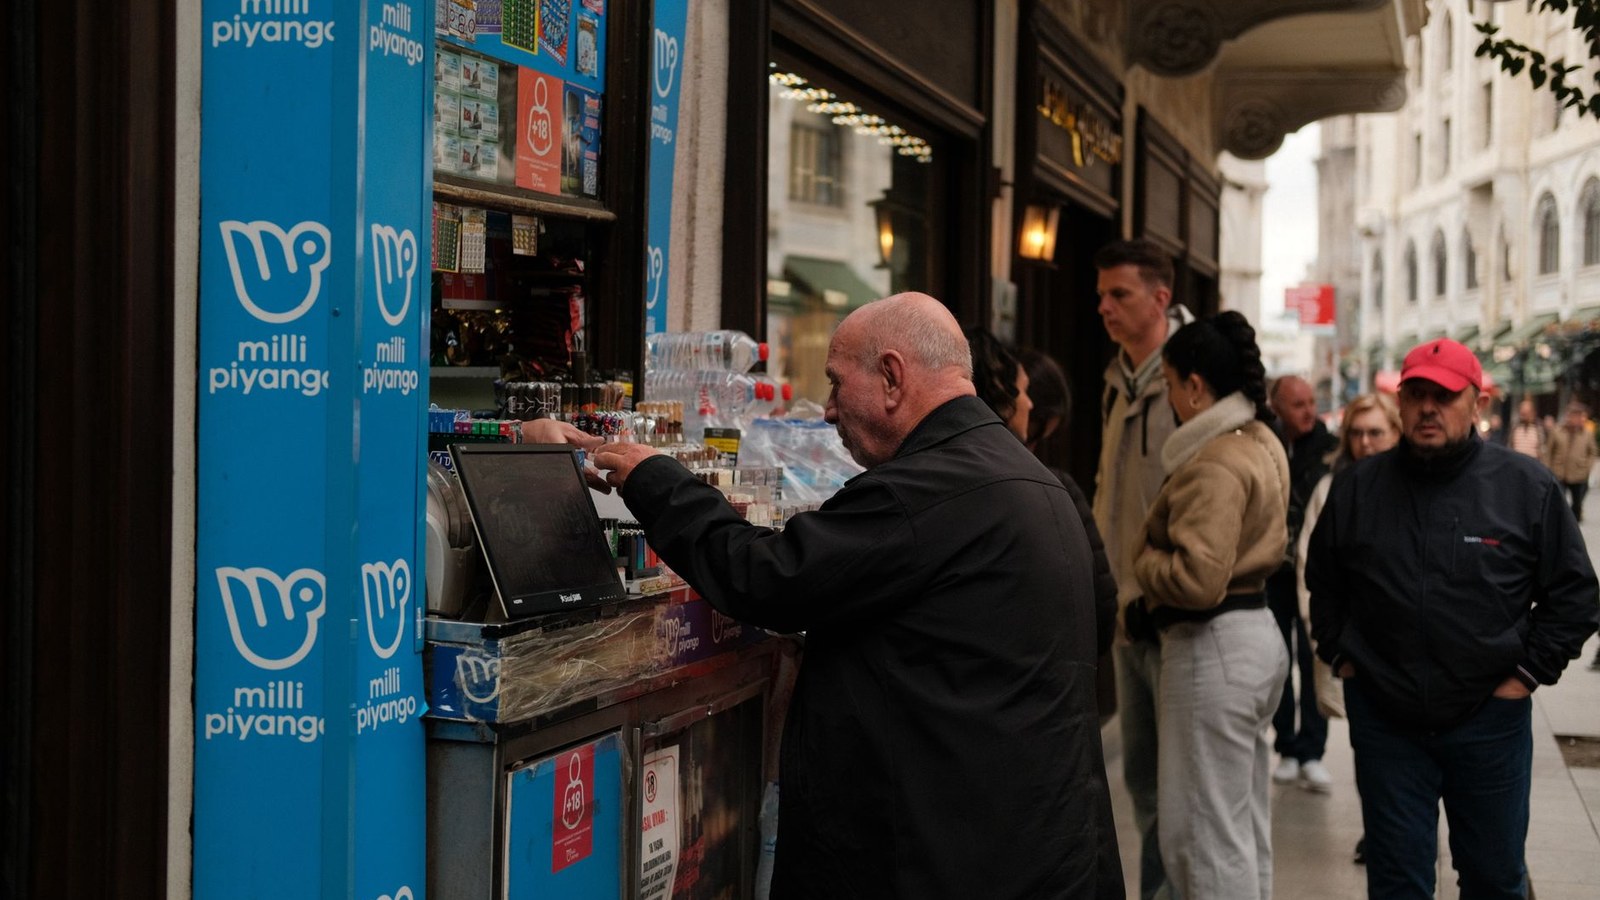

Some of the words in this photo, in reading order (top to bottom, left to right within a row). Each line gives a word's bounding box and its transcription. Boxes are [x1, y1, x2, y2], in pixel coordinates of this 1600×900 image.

[383, 3, 411, 32] milli
[370, 23, 424, 66] piyango
[532, 119, 548, 139] +18
[238, 334, 307, 362] milli
[377, 337, 405, 363] milli
[363, 362, 418, 395] piyango
[679, 637, 699, 652] piyango
[234, 680, 303, 709] milli
[370, 667, 400, 698] milli
[205, 707, 325, 742] piyang
[357, 695, 416, 735] piyango
[566, 791, 581, 812] +18
